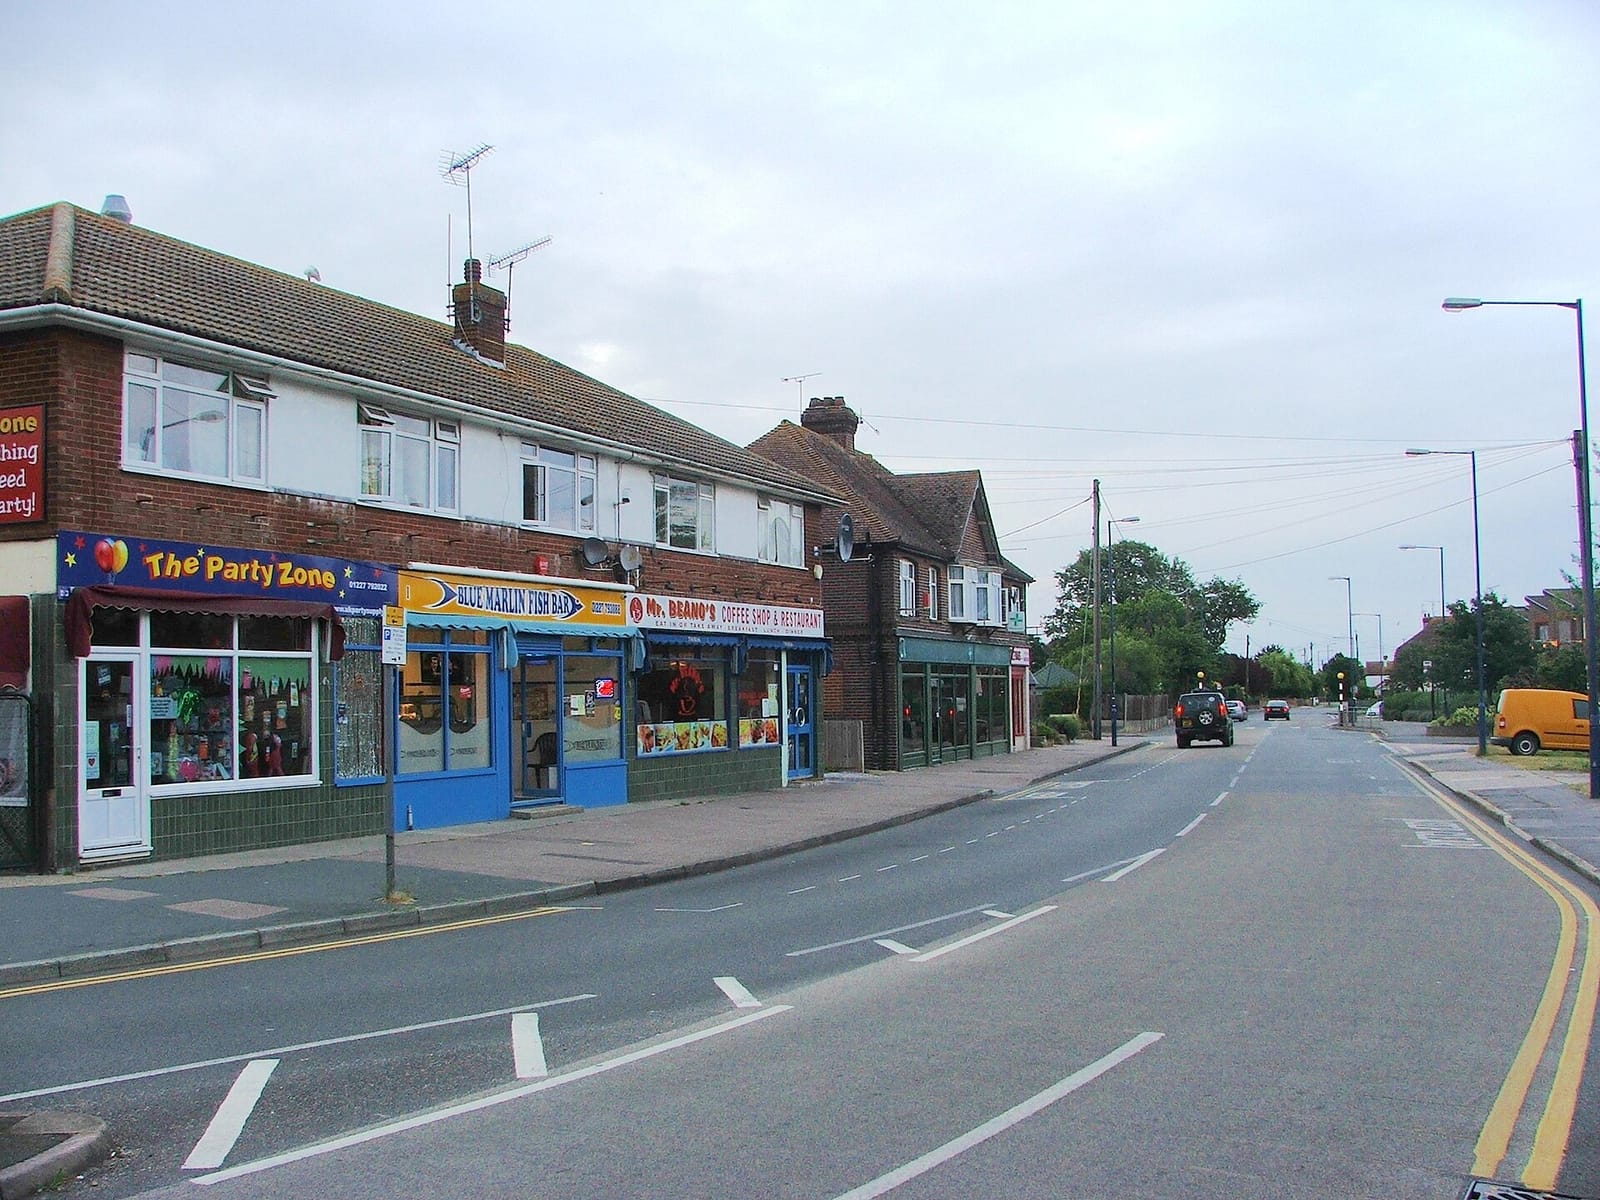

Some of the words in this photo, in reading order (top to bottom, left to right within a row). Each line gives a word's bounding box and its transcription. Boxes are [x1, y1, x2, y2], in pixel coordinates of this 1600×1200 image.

[144, 552, 200, 578] The
[205, 555, 274, 589] Party
[277, 562, 336, 591] Zone
[457, 585, 483, 608] BLUE
[485, 586, 524, 614] MARLIN
[528, 589, 550, 615] FISH
[551, 592, 570, 615] BAR
[668, 600, 716, 622] BEANO'S
[722, 605, 750, 625] COFFEE
[752, 608, 771, 626] SHOP
[773, 610, 779, 626] &
[781, 610, 822, 629] RESTAURANT
